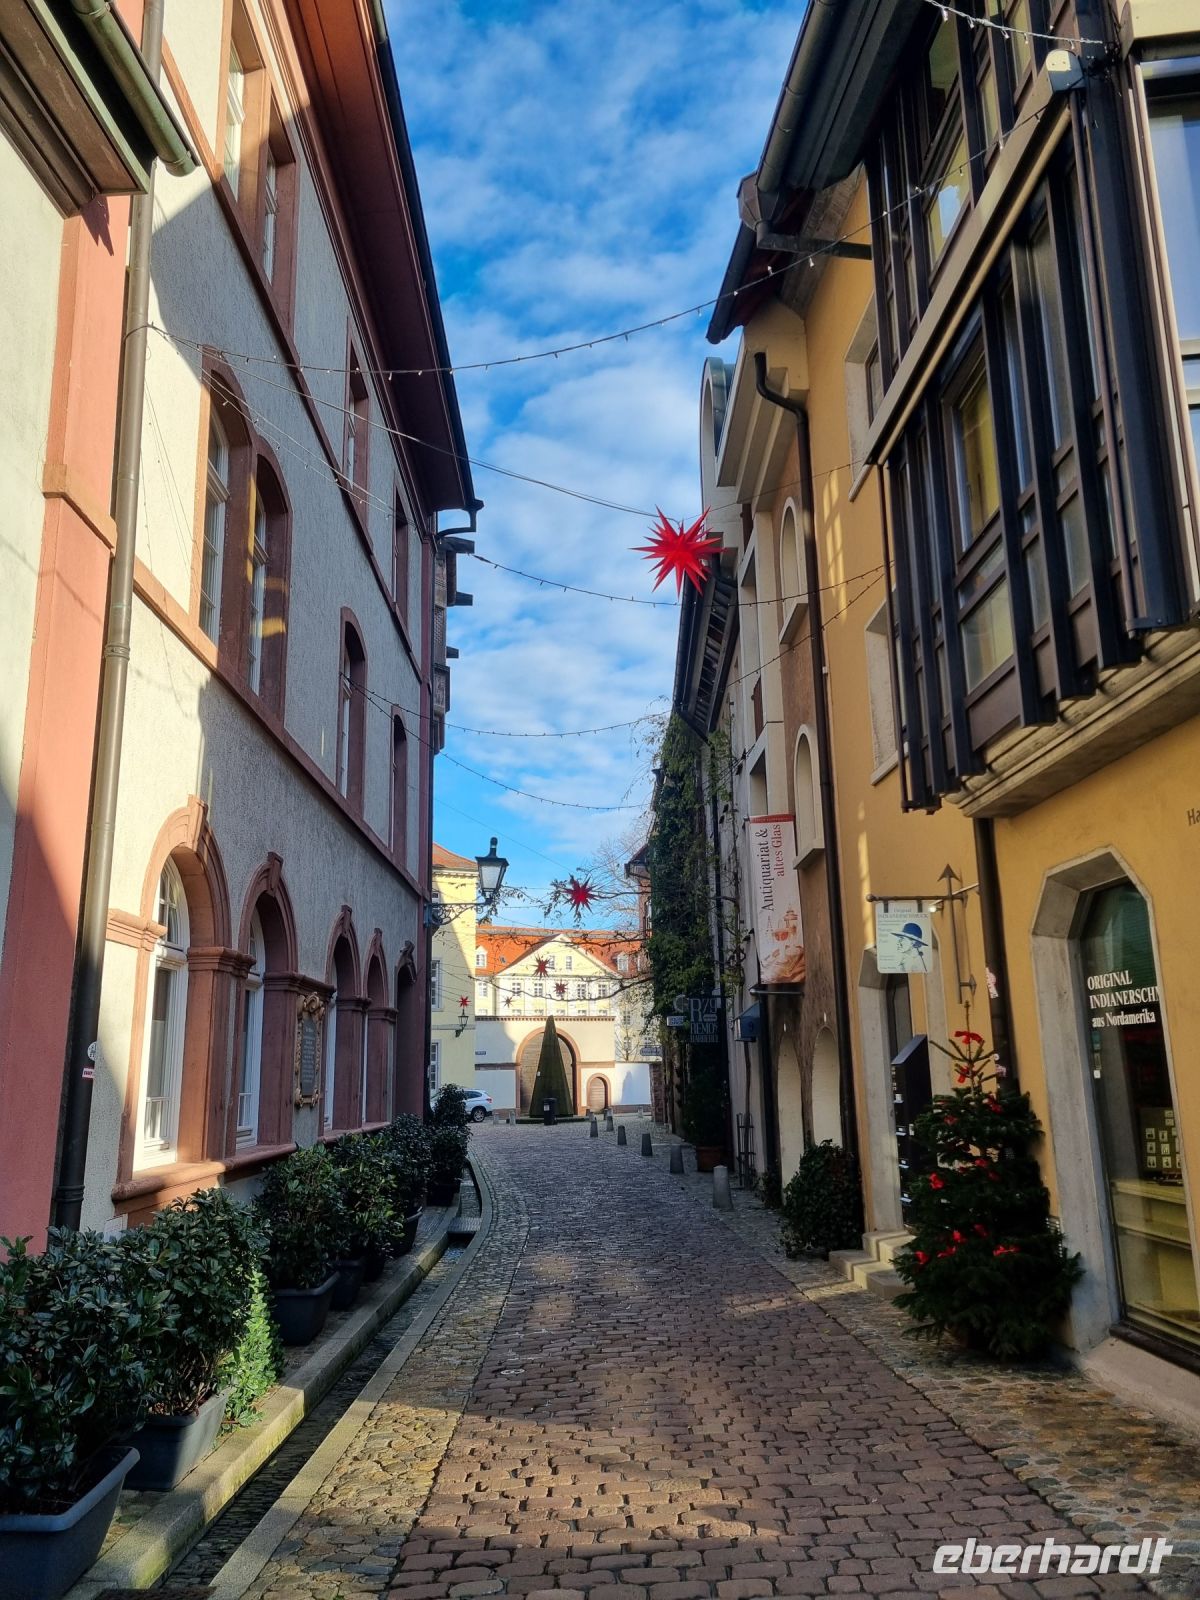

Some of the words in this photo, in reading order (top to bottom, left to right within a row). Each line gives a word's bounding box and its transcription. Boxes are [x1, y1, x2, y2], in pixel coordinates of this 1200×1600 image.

[755, 828, 768, 838] &
[771, 824, 783, 848] Glas
[774, 850, 785, 877] altes
[757, 840, 774, 911] Antiquariat
[1087, 968, 1133, 990] ORIGINAL
[1092, 1016, 1105, 1028] aus
[1105, 1008, 1157, 1027] Nordamerika
